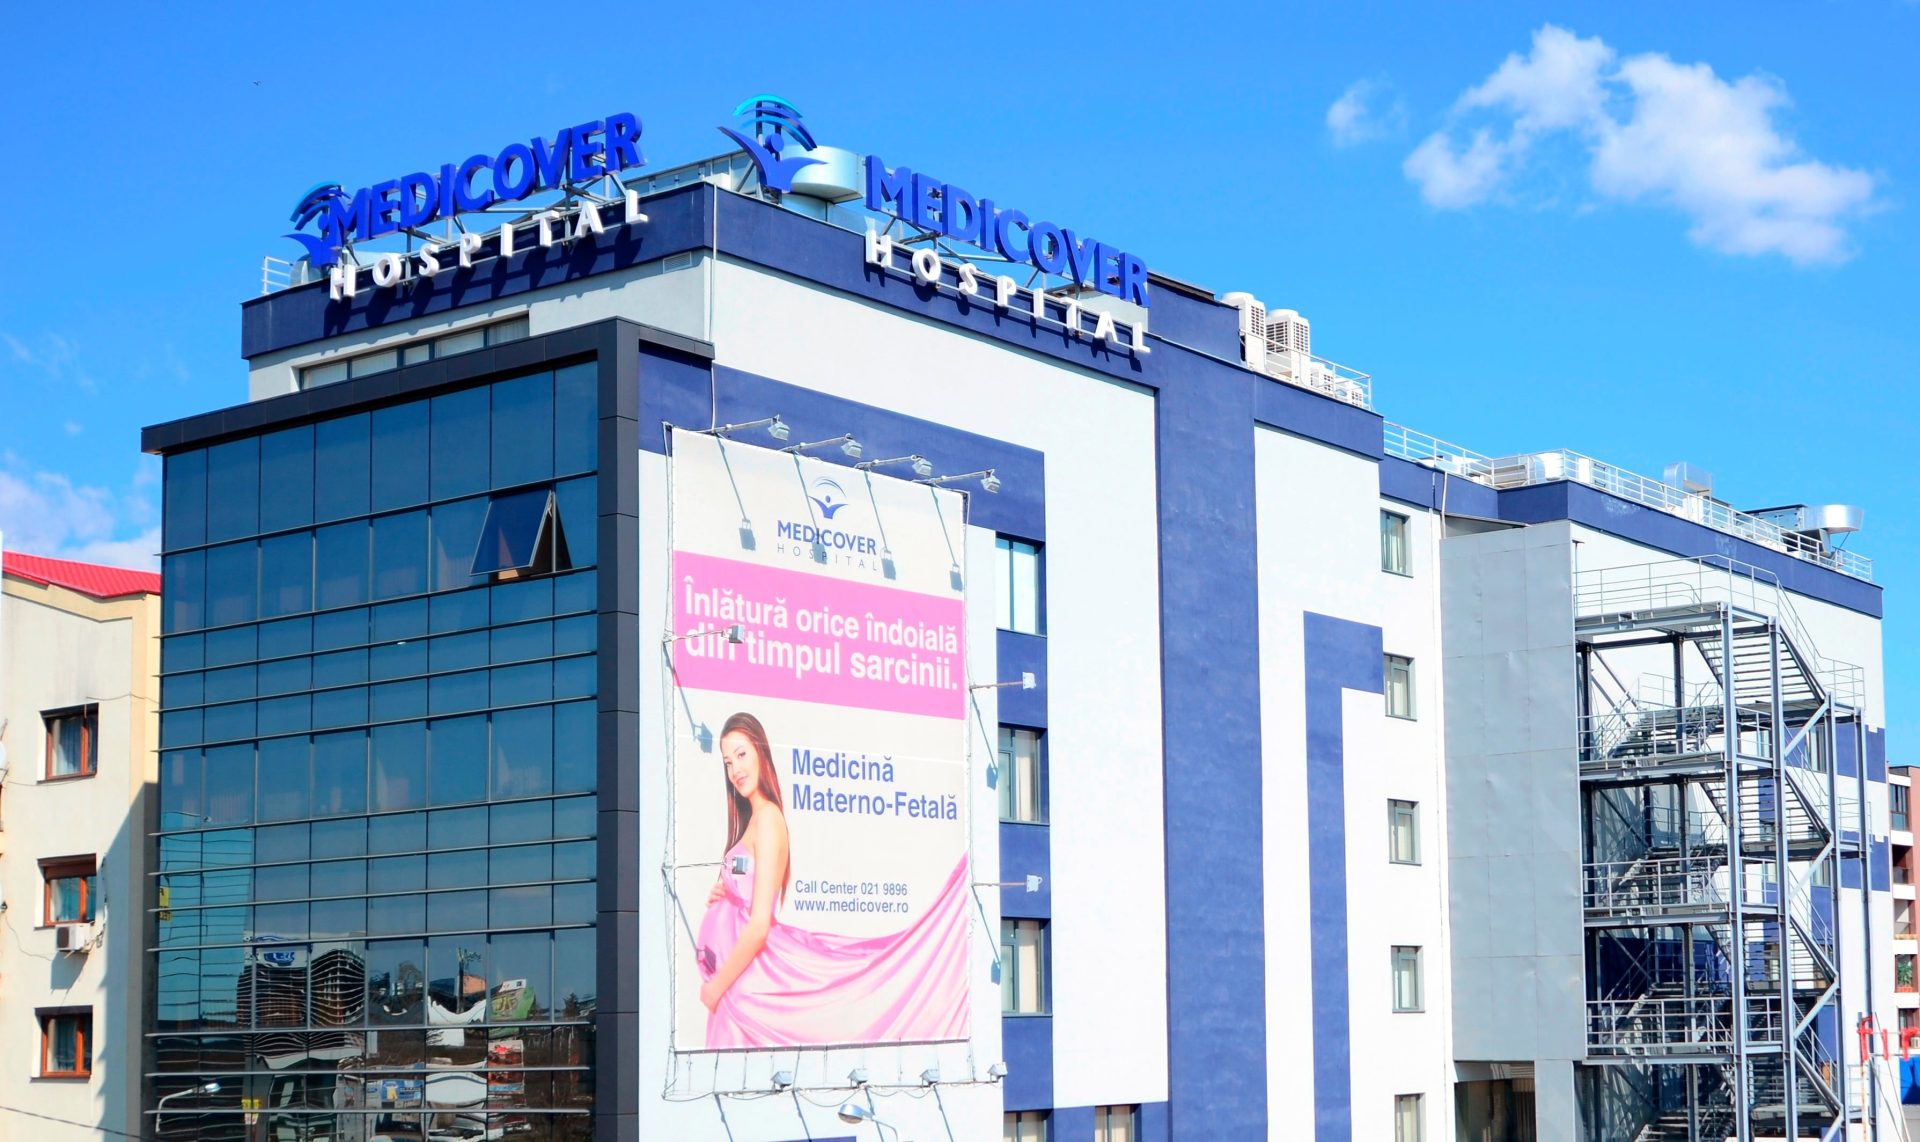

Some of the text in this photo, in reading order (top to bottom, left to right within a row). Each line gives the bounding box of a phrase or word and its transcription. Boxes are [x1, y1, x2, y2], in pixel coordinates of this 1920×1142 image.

[327, 112, 647, 249] MEDICOVER
[329, 189, 649, 300] HOSPITAL
[865, 155, 1151, 308] MEDICOVER
[865, 229, 1151, 353] HOSPITAL
[777, 519, 877, 556] MEDICOVER
[777, 543, 878, 571] HOSPITAL
[684, 576, 958, 655] Înlătură orice îndoială
[746, 630, 841, 680] timpul
[850, 651, 958, 691] sarcinii.
[792, 748, 894, 783] Medicină
[792, 783, 958, 820] Materno-Fetală
[794, 898, 909, 913] www.medicover.ro
[795, 880, 908, 896] Call Center 021 9896
